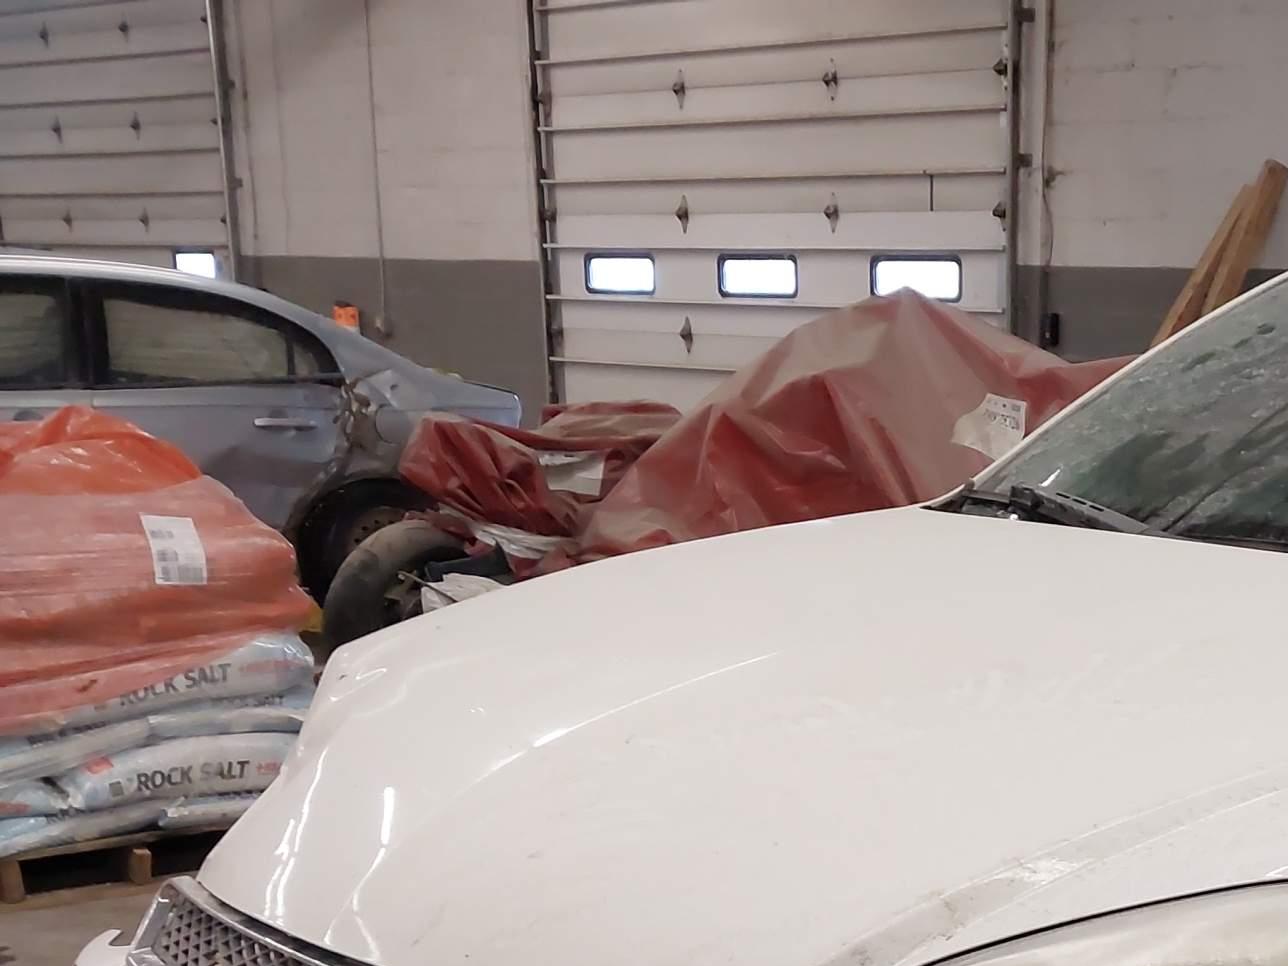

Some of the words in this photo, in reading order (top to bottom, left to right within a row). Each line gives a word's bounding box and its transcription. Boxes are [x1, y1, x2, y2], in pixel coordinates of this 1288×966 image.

[184, 663, 231, 689] SALT
[136, 765, 193, 792] ROCK
[200, 760, 249, 783] SALT
